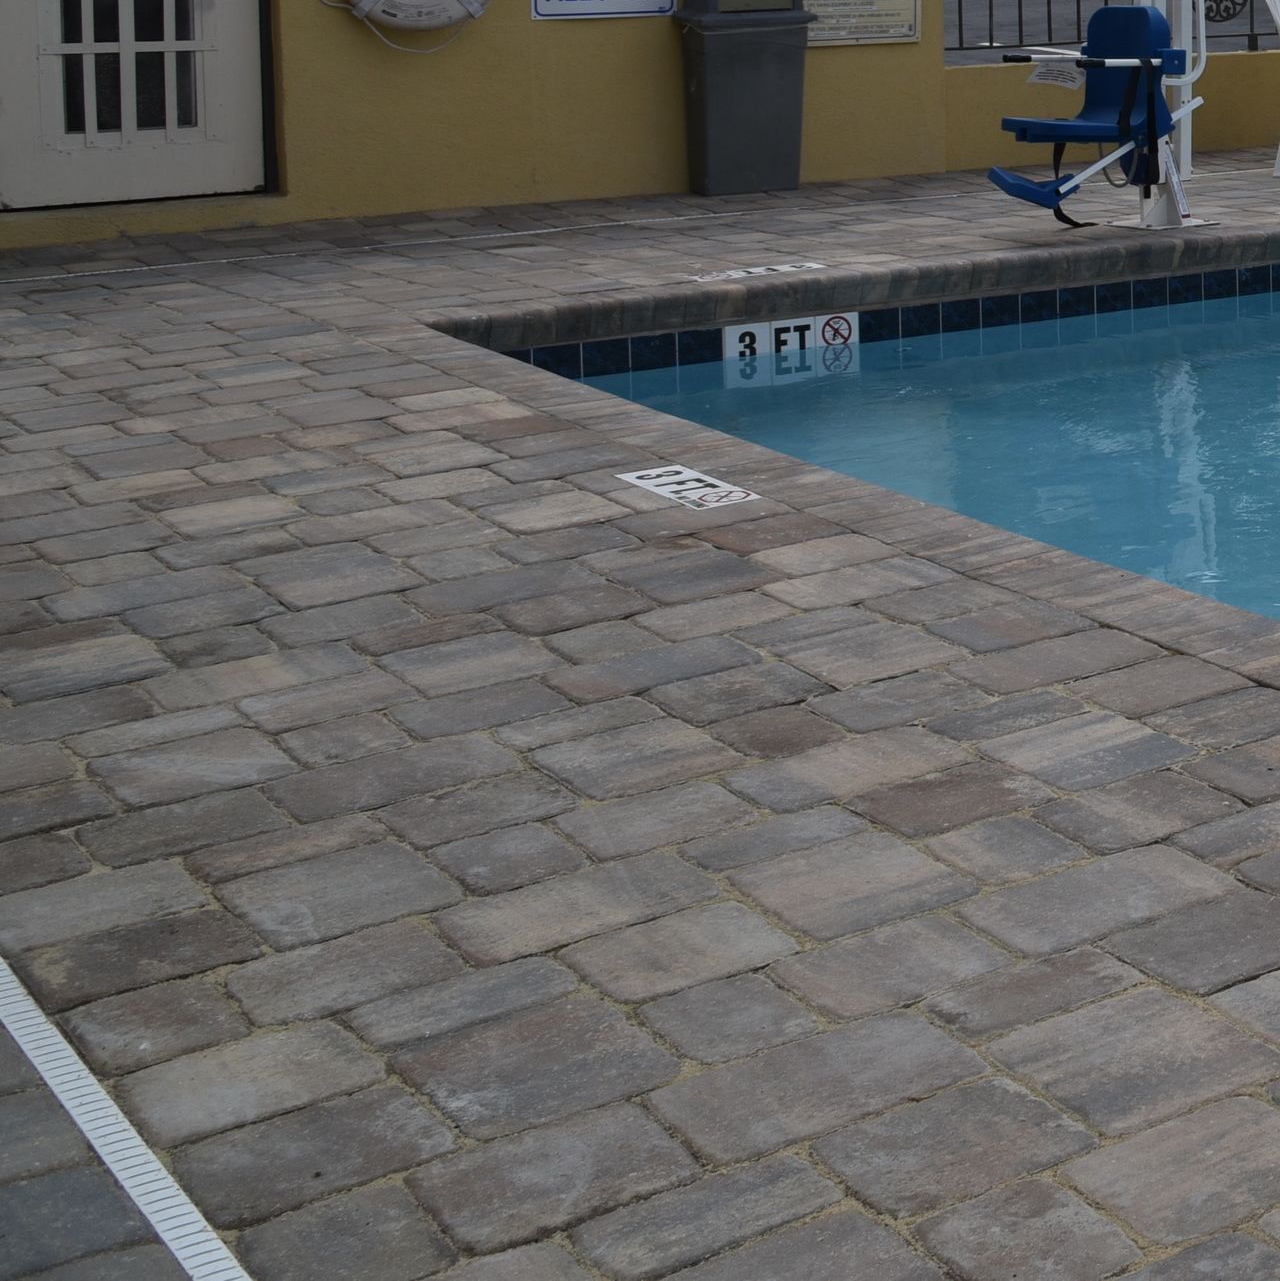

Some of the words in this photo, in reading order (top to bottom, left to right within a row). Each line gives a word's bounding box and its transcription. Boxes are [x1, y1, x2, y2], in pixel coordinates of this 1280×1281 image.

[738, 330, 758, 358] 3
[774, 324, 811, 355] FT
[635, 470, 684, 481] 3
